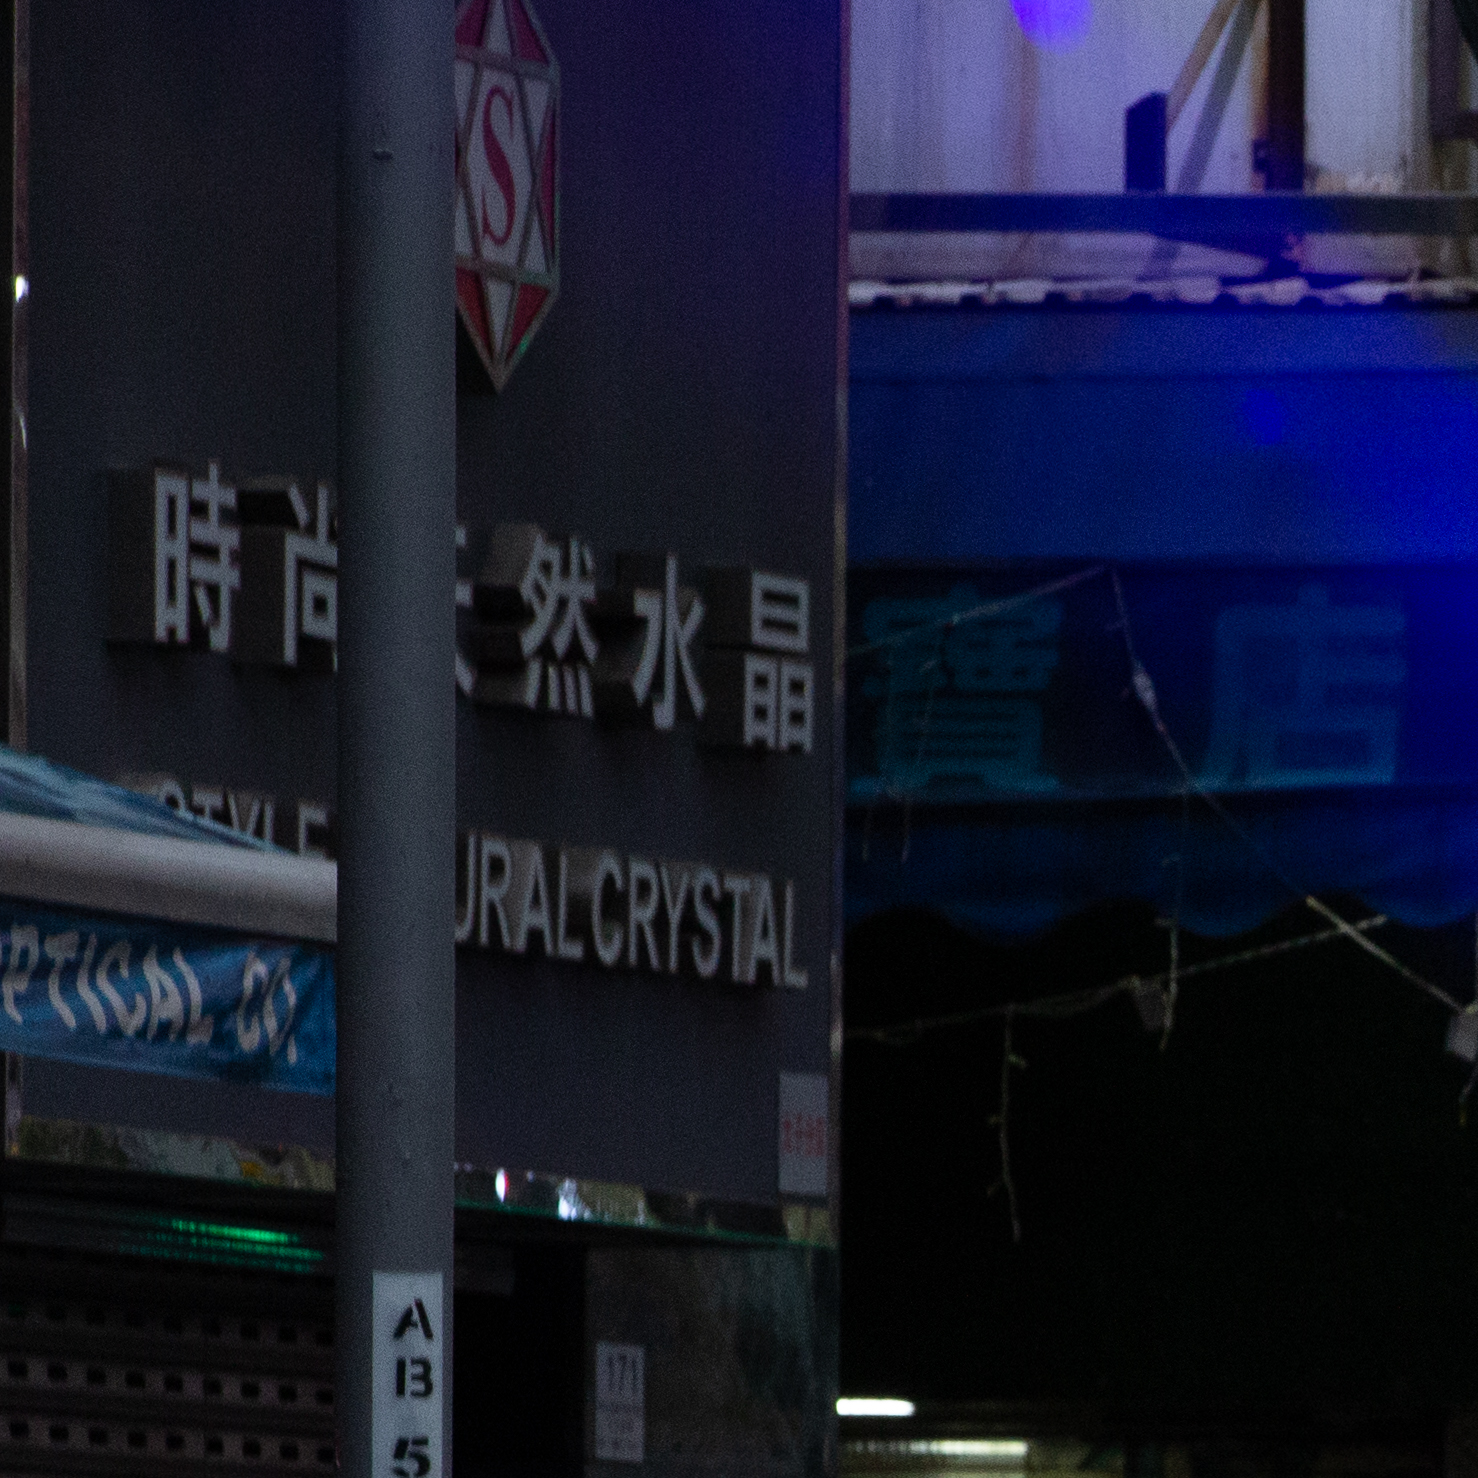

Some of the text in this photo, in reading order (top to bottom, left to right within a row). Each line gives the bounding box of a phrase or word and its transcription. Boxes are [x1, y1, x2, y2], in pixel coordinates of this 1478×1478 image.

[153, 458, 816, 755] 時尚然水晶
[0, 920, 214, 1046] PTICAL
[454, 831, 586, 963] URAL
[590, 849, 809, 990] CRYSTAL
